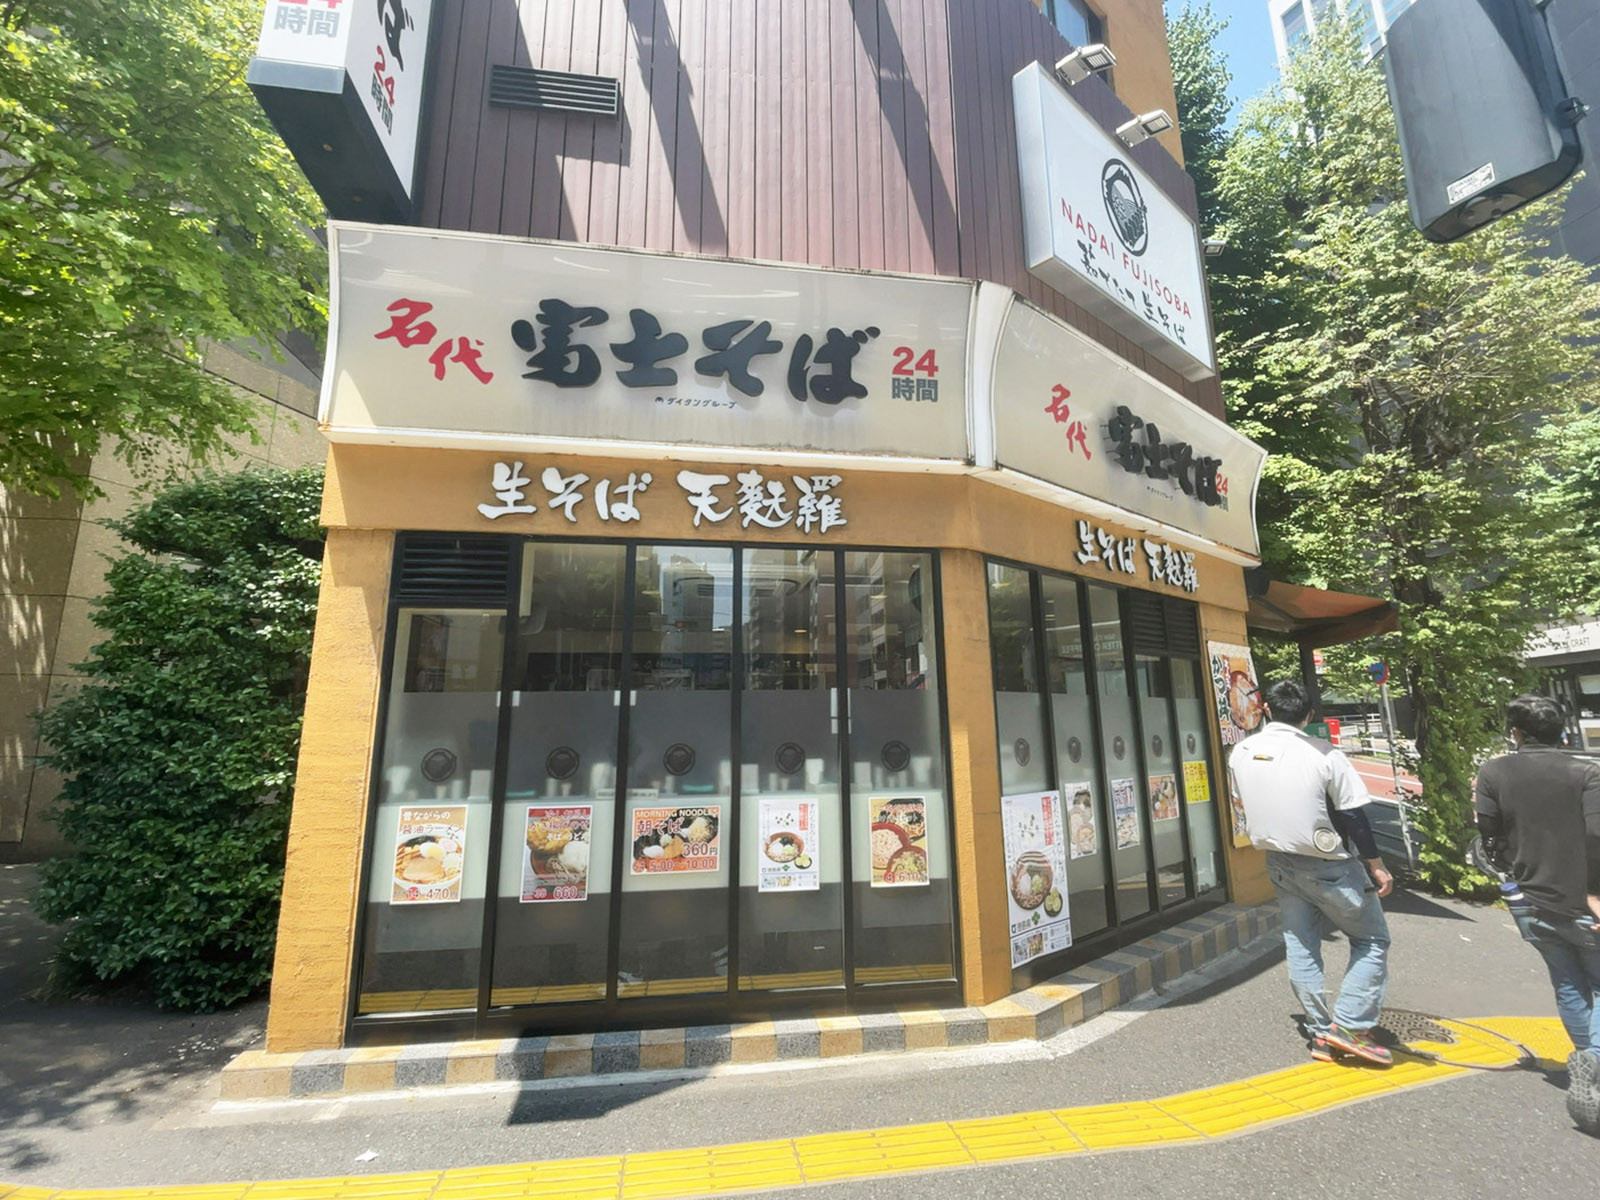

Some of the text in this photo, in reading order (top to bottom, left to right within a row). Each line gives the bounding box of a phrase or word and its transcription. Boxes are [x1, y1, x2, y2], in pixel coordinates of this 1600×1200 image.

[274, 5, 341, 39] 時間
[371, 72, 393, 136] 時間
[1061, 198, 1192, 320] NADAI FUJISOBA
[374, 297, 881, 406] 名代 富士そば
[892, 346, 939, 378] 24
[892, 377, 939, 403] 時間
[1044, 383, 1092, 461] 名代
[476, 461, 653, 523] 生そば
[1215, 473, 1229, 495] 24
[1075, 520, 1137, 575] 生そば
[636, 808, 719, 818] MORNING NOODLES
[637, 816, 685, 836] 朝そば
